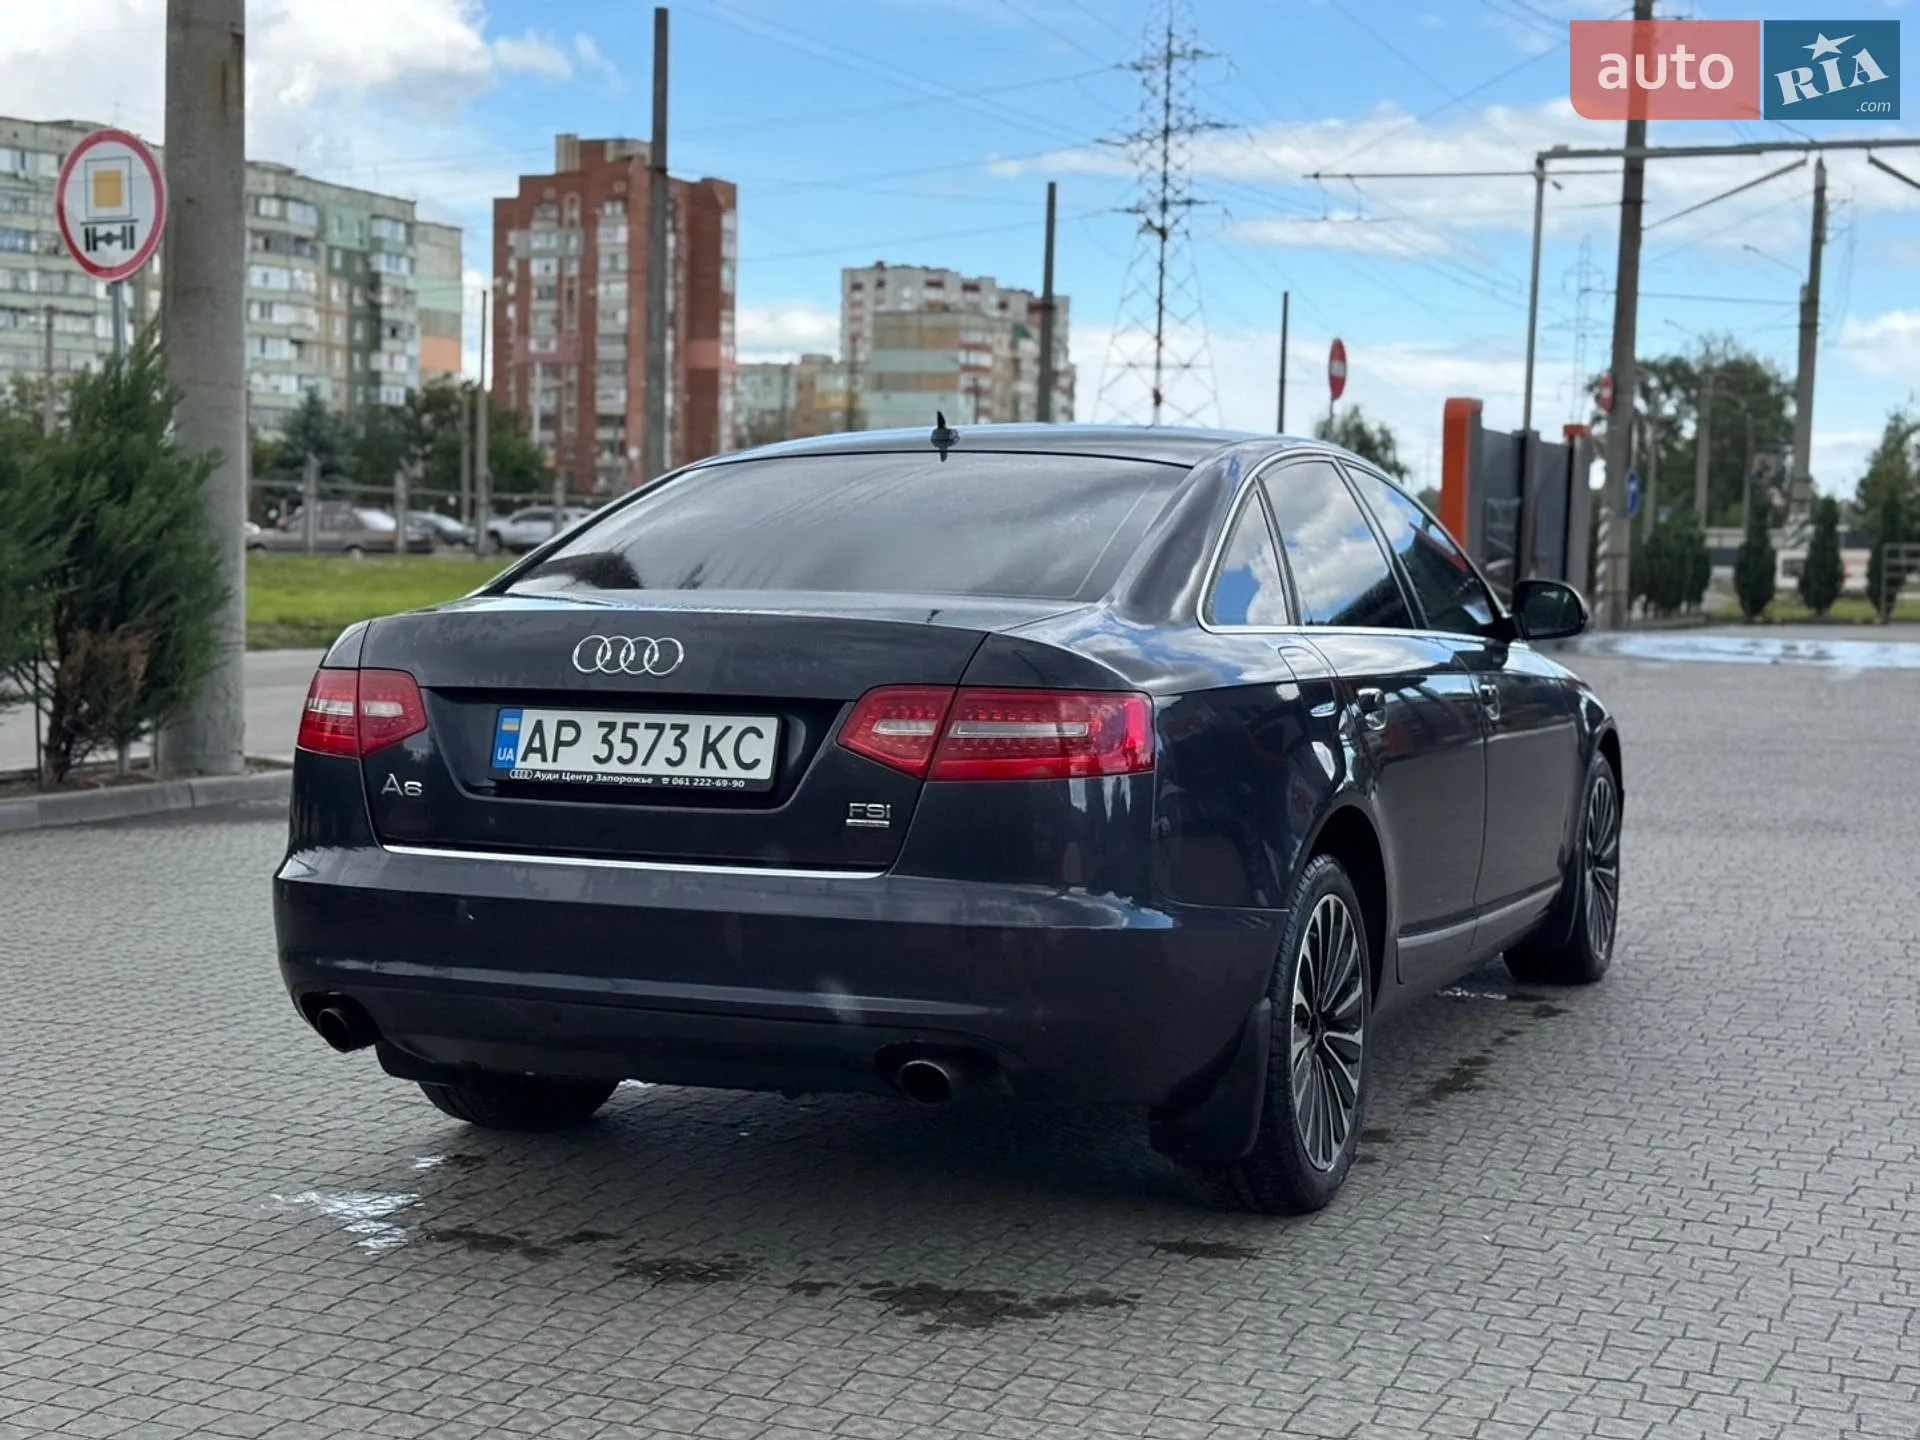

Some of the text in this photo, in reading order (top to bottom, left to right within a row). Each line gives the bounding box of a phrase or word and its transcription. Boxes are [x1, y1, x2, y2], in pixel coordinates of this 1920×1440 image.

[497, 747, 515, 761] UA
[520, 719, 764, 771] AP 3573 KC
[381, 773, 423, 797] A6
[533, 770, 745, 788] Ауди Центр Запорожье 061 222-69-90
